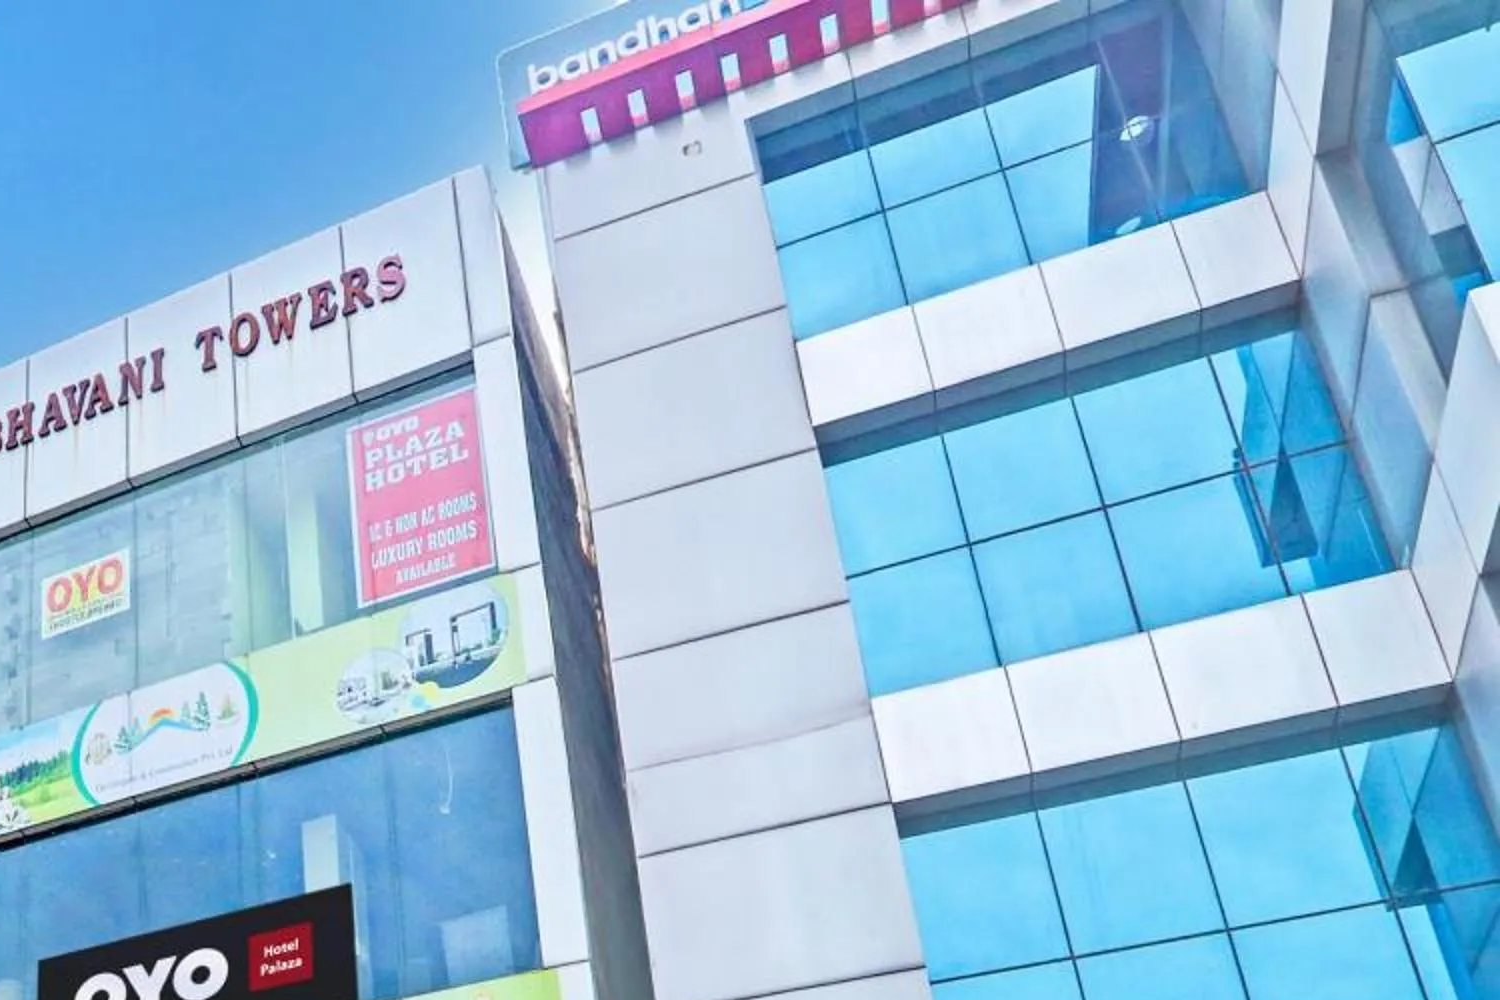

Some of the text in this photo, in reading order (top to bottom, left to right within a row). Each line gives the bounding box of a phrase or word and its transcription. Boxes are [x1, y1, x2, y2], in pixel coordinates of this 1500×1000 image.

[195, 254, 408, 373] TOWERS
[365, 421, 464, 470] PLAZA
[365, 444, 469, 493] HOTEL
[421, 505, 435, 527] AC
[438, 491, 477, 520] ROOMS
[371, 519, 477, 569] LUXURY ROOMS
[47, 558, 123, 613] OYO
[260, 957, 303, 977] Palaza
[263, 937, 299, 958] Hotel
